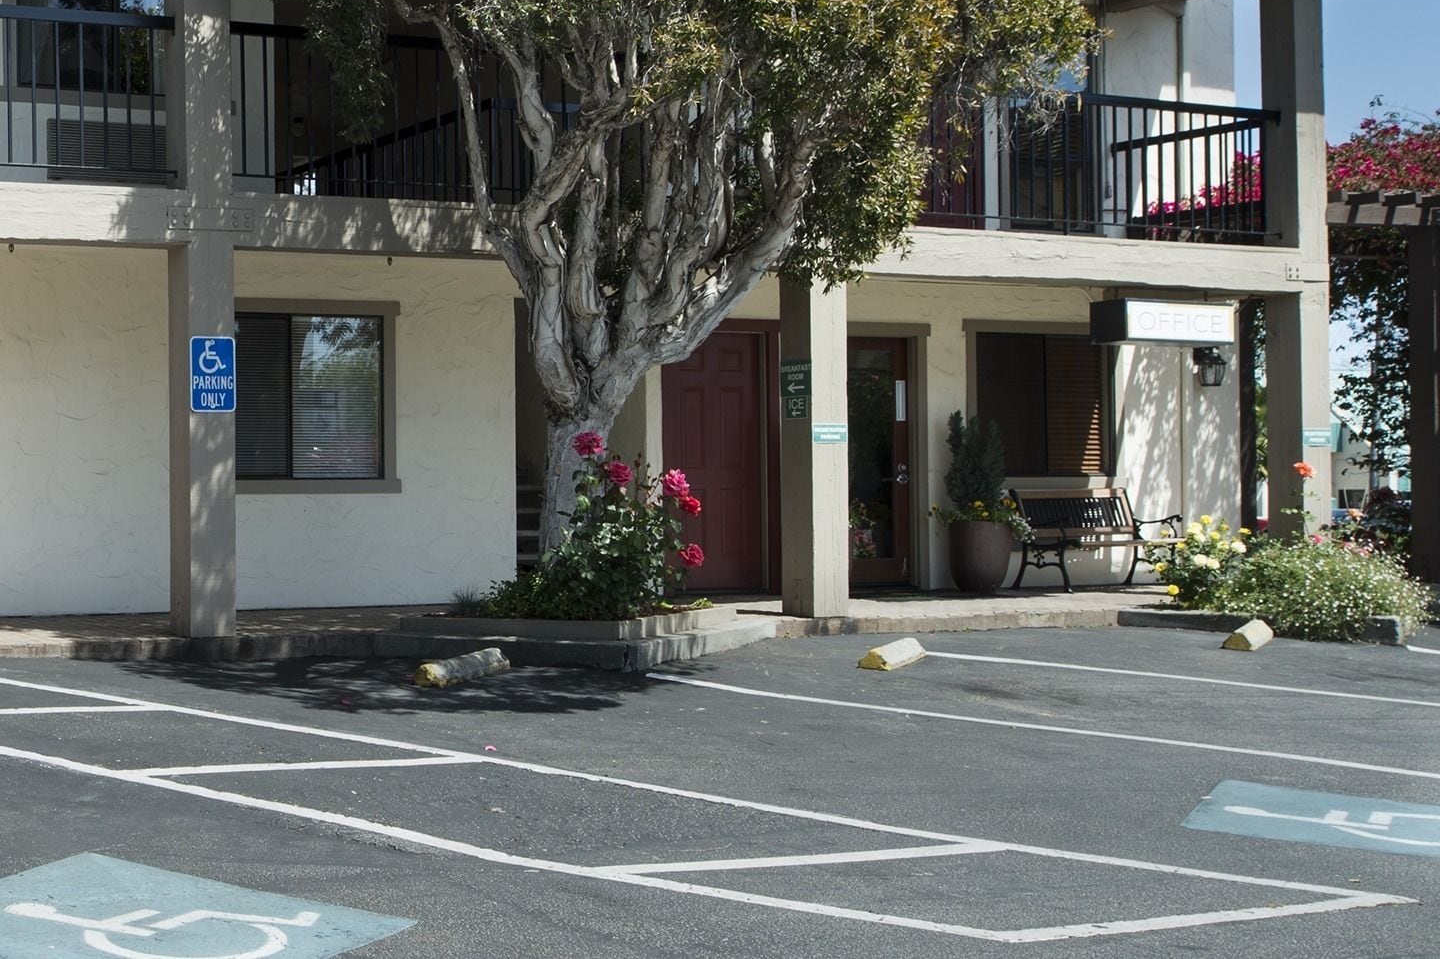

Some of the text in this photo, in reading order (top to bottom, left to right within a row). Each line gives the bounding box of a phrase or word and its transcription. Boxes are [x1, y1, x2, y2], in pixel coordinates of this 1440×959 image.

[1138, 311, 1224, 334] OFFICE
[780, 363, 811, 373] BREAKFAST
[193, 375, 234, 390] PARKING
[787, 373, 804, 381] ROOM
[200, 392, 226, 407] ONLY
[788, 398, 805, 410] ICE
